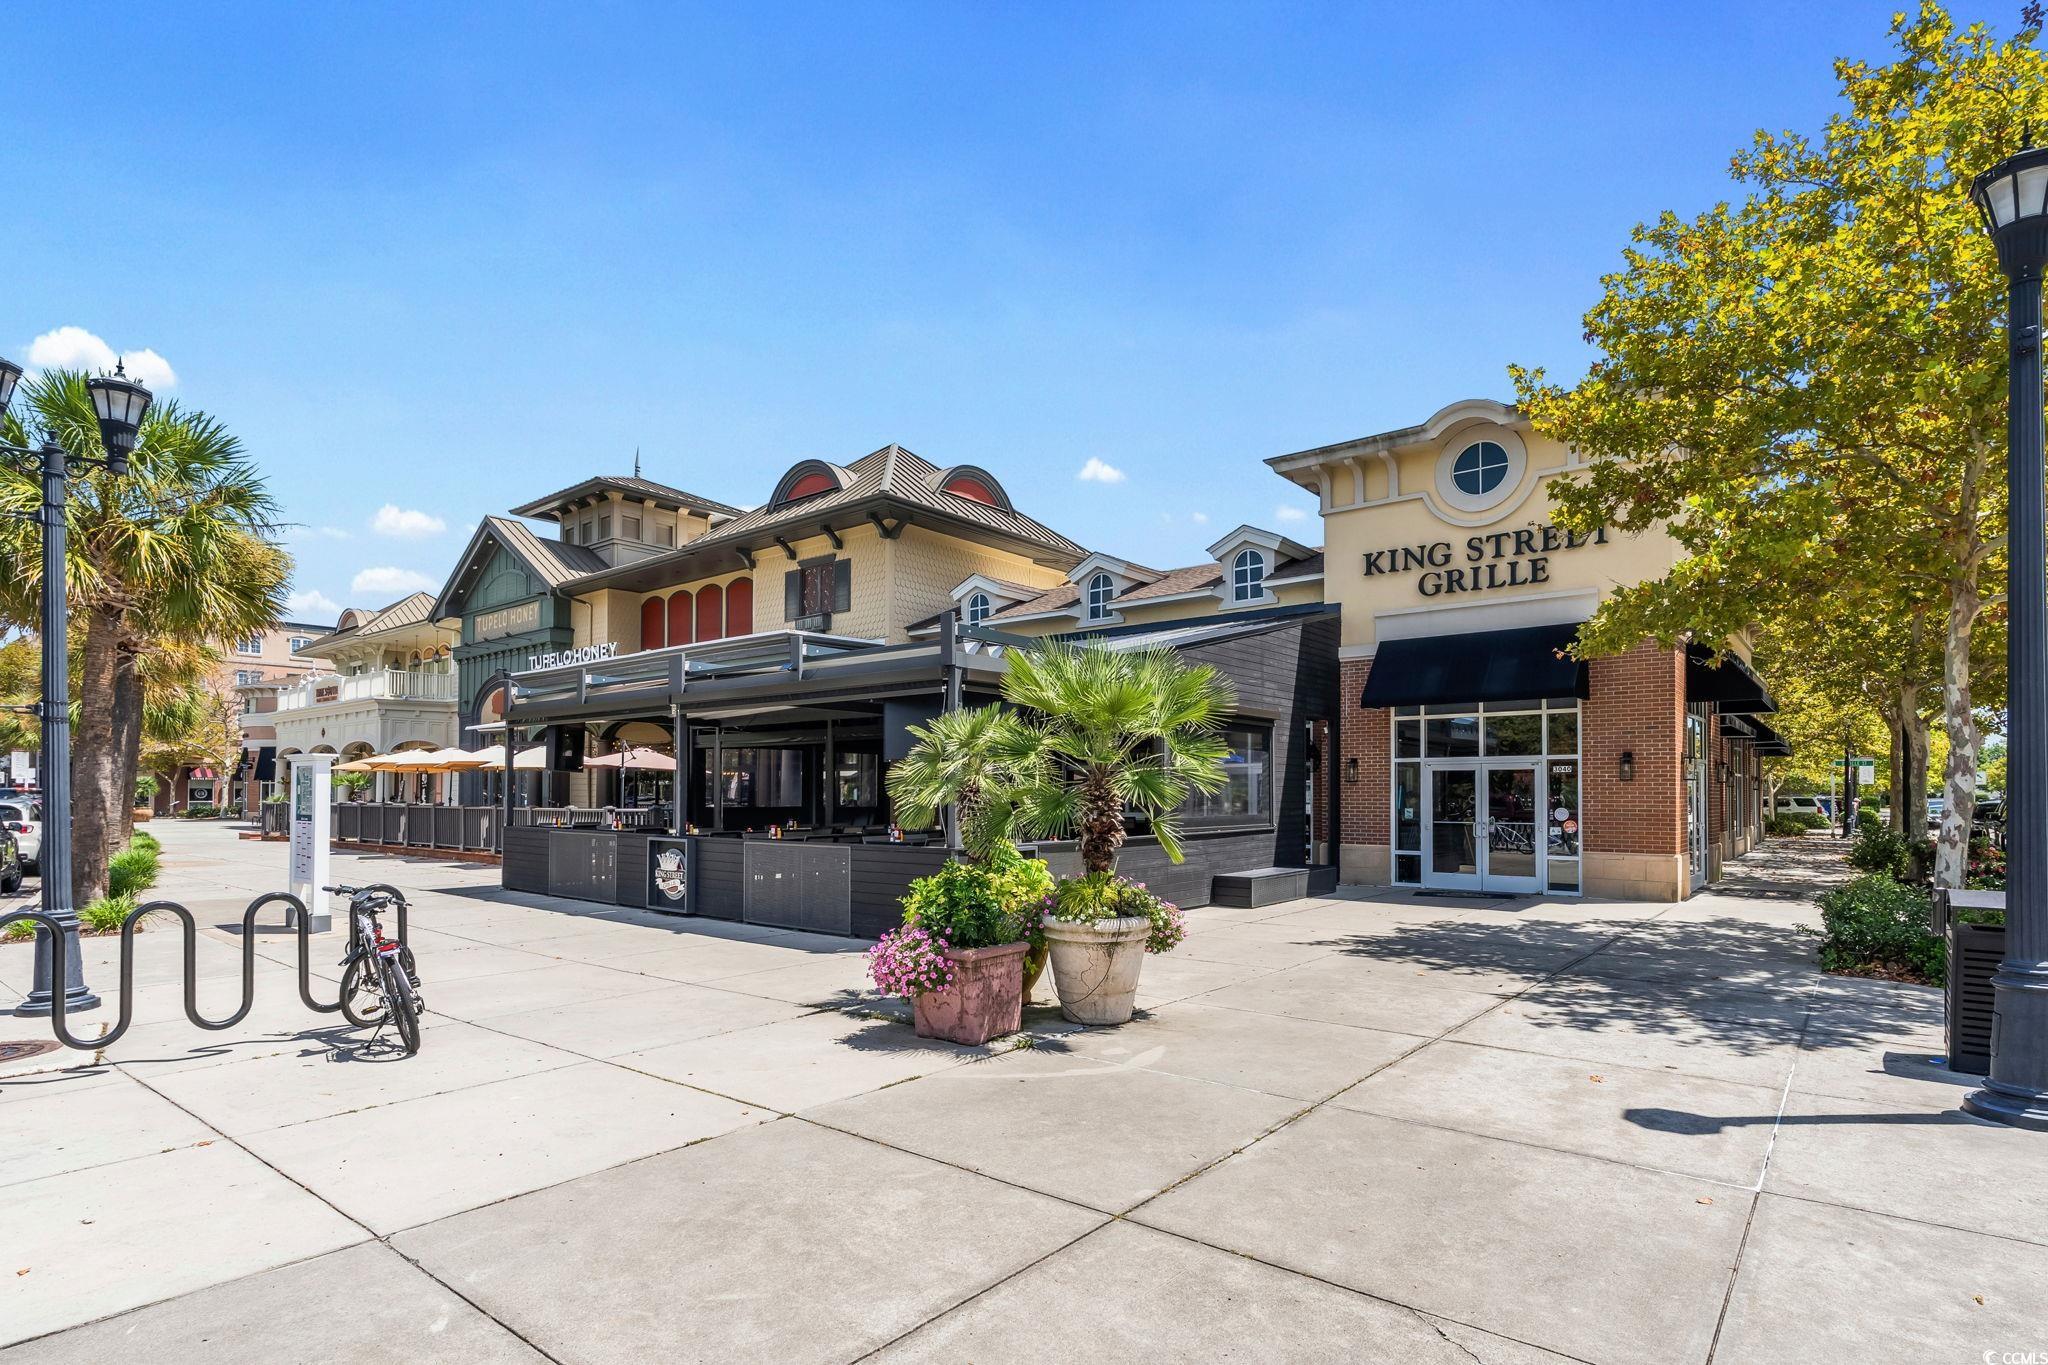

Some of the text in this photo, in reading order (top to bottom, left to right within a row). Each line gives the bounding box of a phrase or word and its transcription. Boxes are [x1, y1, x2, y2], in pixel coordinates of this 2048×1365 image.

[1362, 542, 1452, 576] KING
[1417, 557, 1550, 597] GRILLE
[476, 611, 508, 633] TUPELO
[510, 601, 539, 625] HONEY
[528, 641, 618, 670] TUPELO HONEY
[1552, 765, 1572, 773] 3040
[667, 870, 684, 880] STREET
